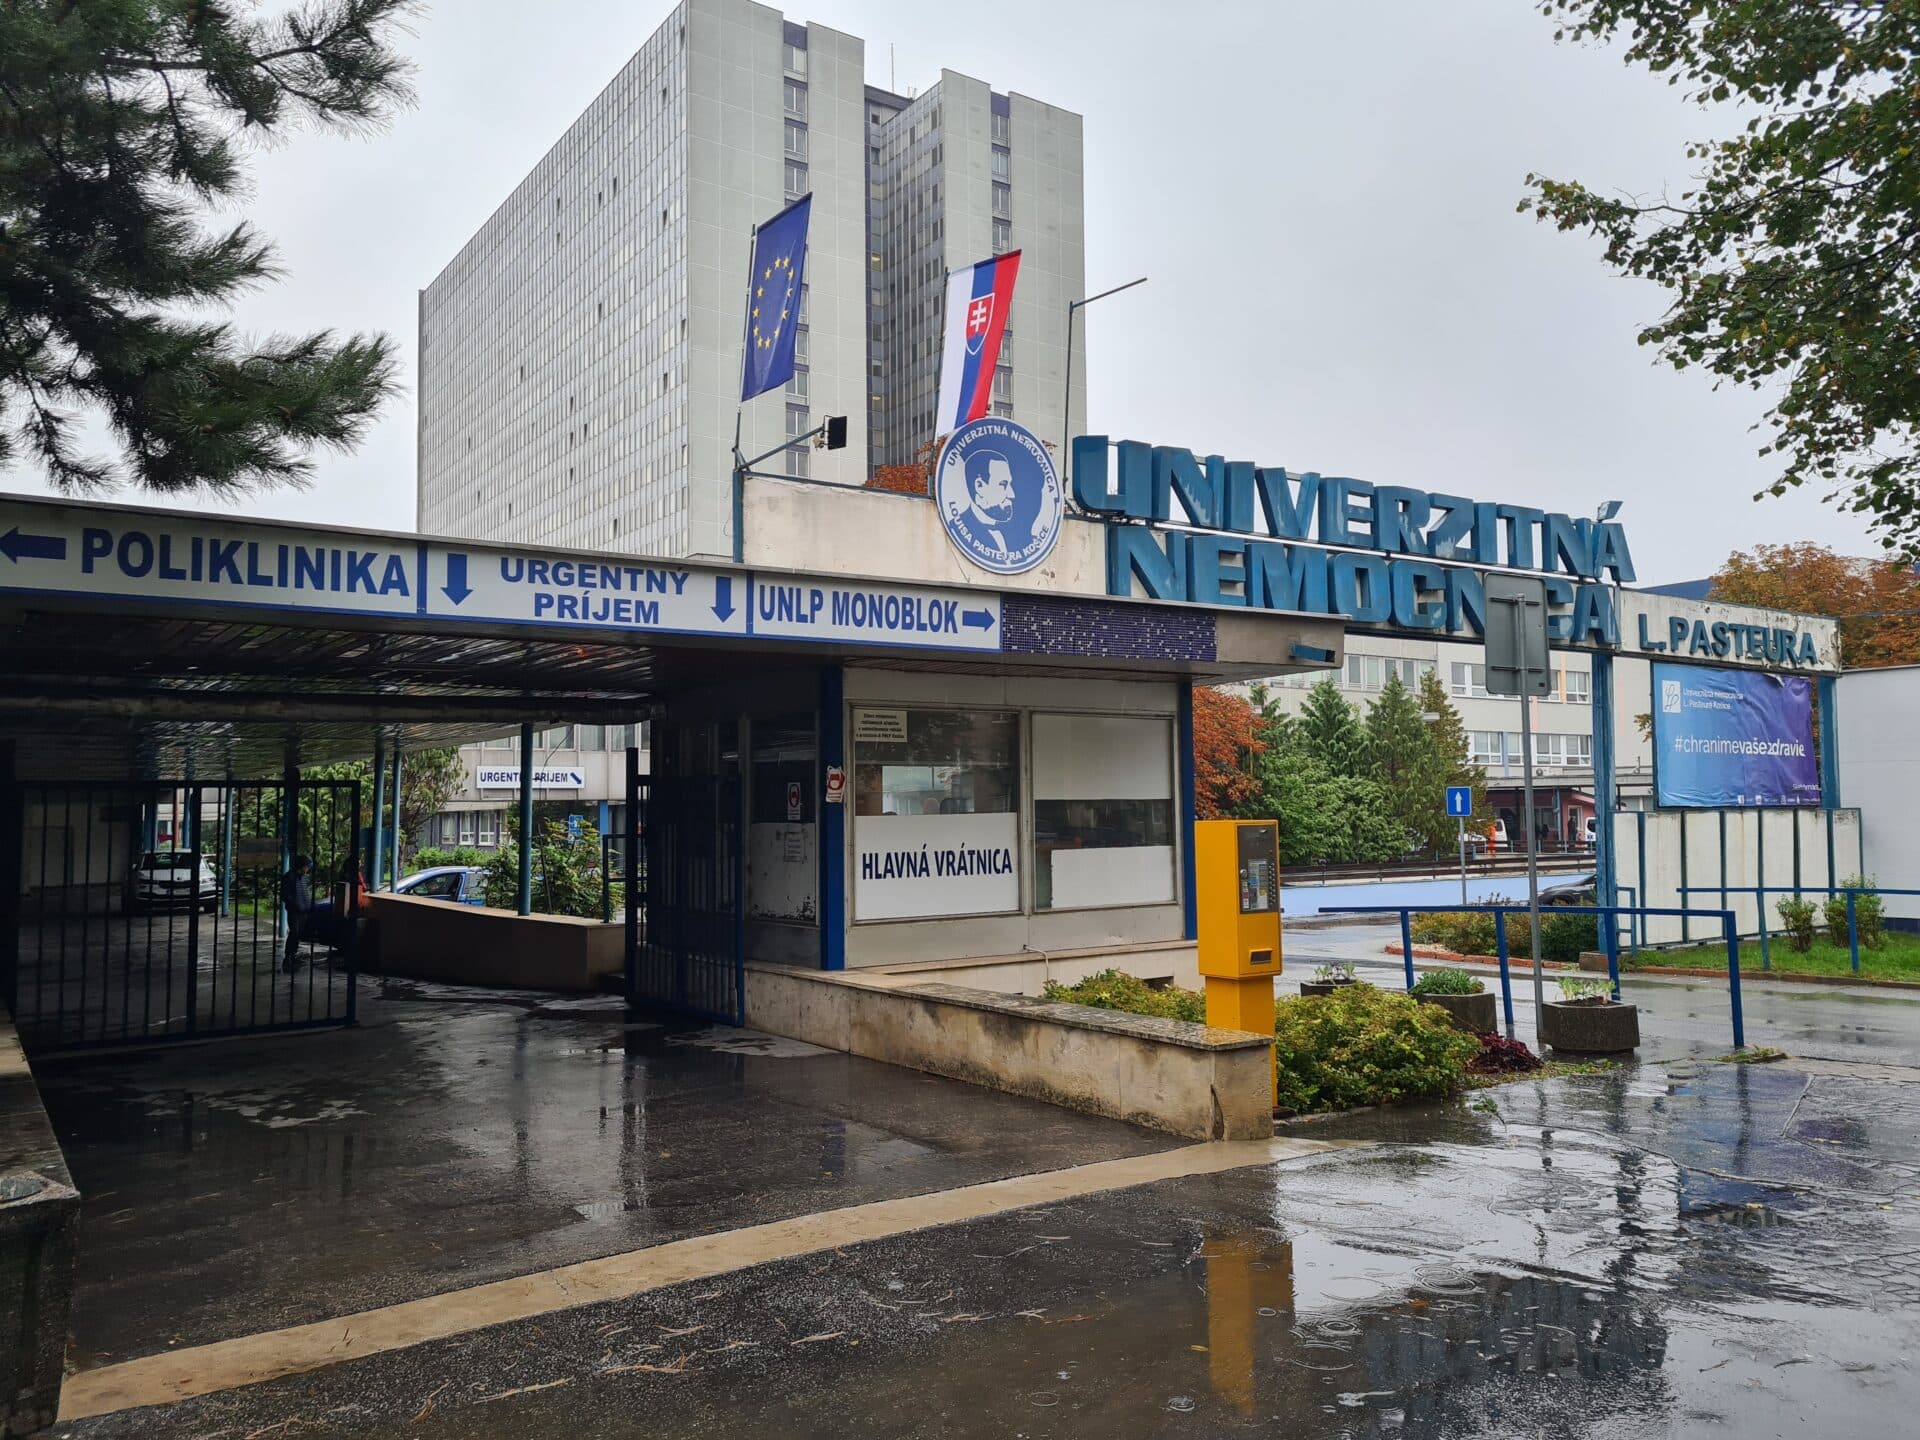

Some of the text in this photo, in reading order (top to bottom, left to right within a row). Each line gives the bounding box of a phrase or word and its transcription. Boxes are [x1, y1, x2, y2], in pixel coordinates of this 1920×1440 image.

[948, 425, 1055, 493] UNIVERZITNÁ NEMOCNICA
[948, 501, 972, 543] LOUISA
[1072, 435, 1636, 582] UNIVERZITNÁ
[81, 527, 410, 597] POLIKLINIKA
[501, 557, 690, 595] URGENTNÝ
[1107, 525, 1622, 645] NEMOCNCA
[534, 591, 659, 625] PRÍJEM
[759, 584, 958, 634] UNLP MONOBLOK
[480, 772, 522, 783] URGENT
[862, 842, 1013, 880] HLAVNÁ VRÁTNICA
